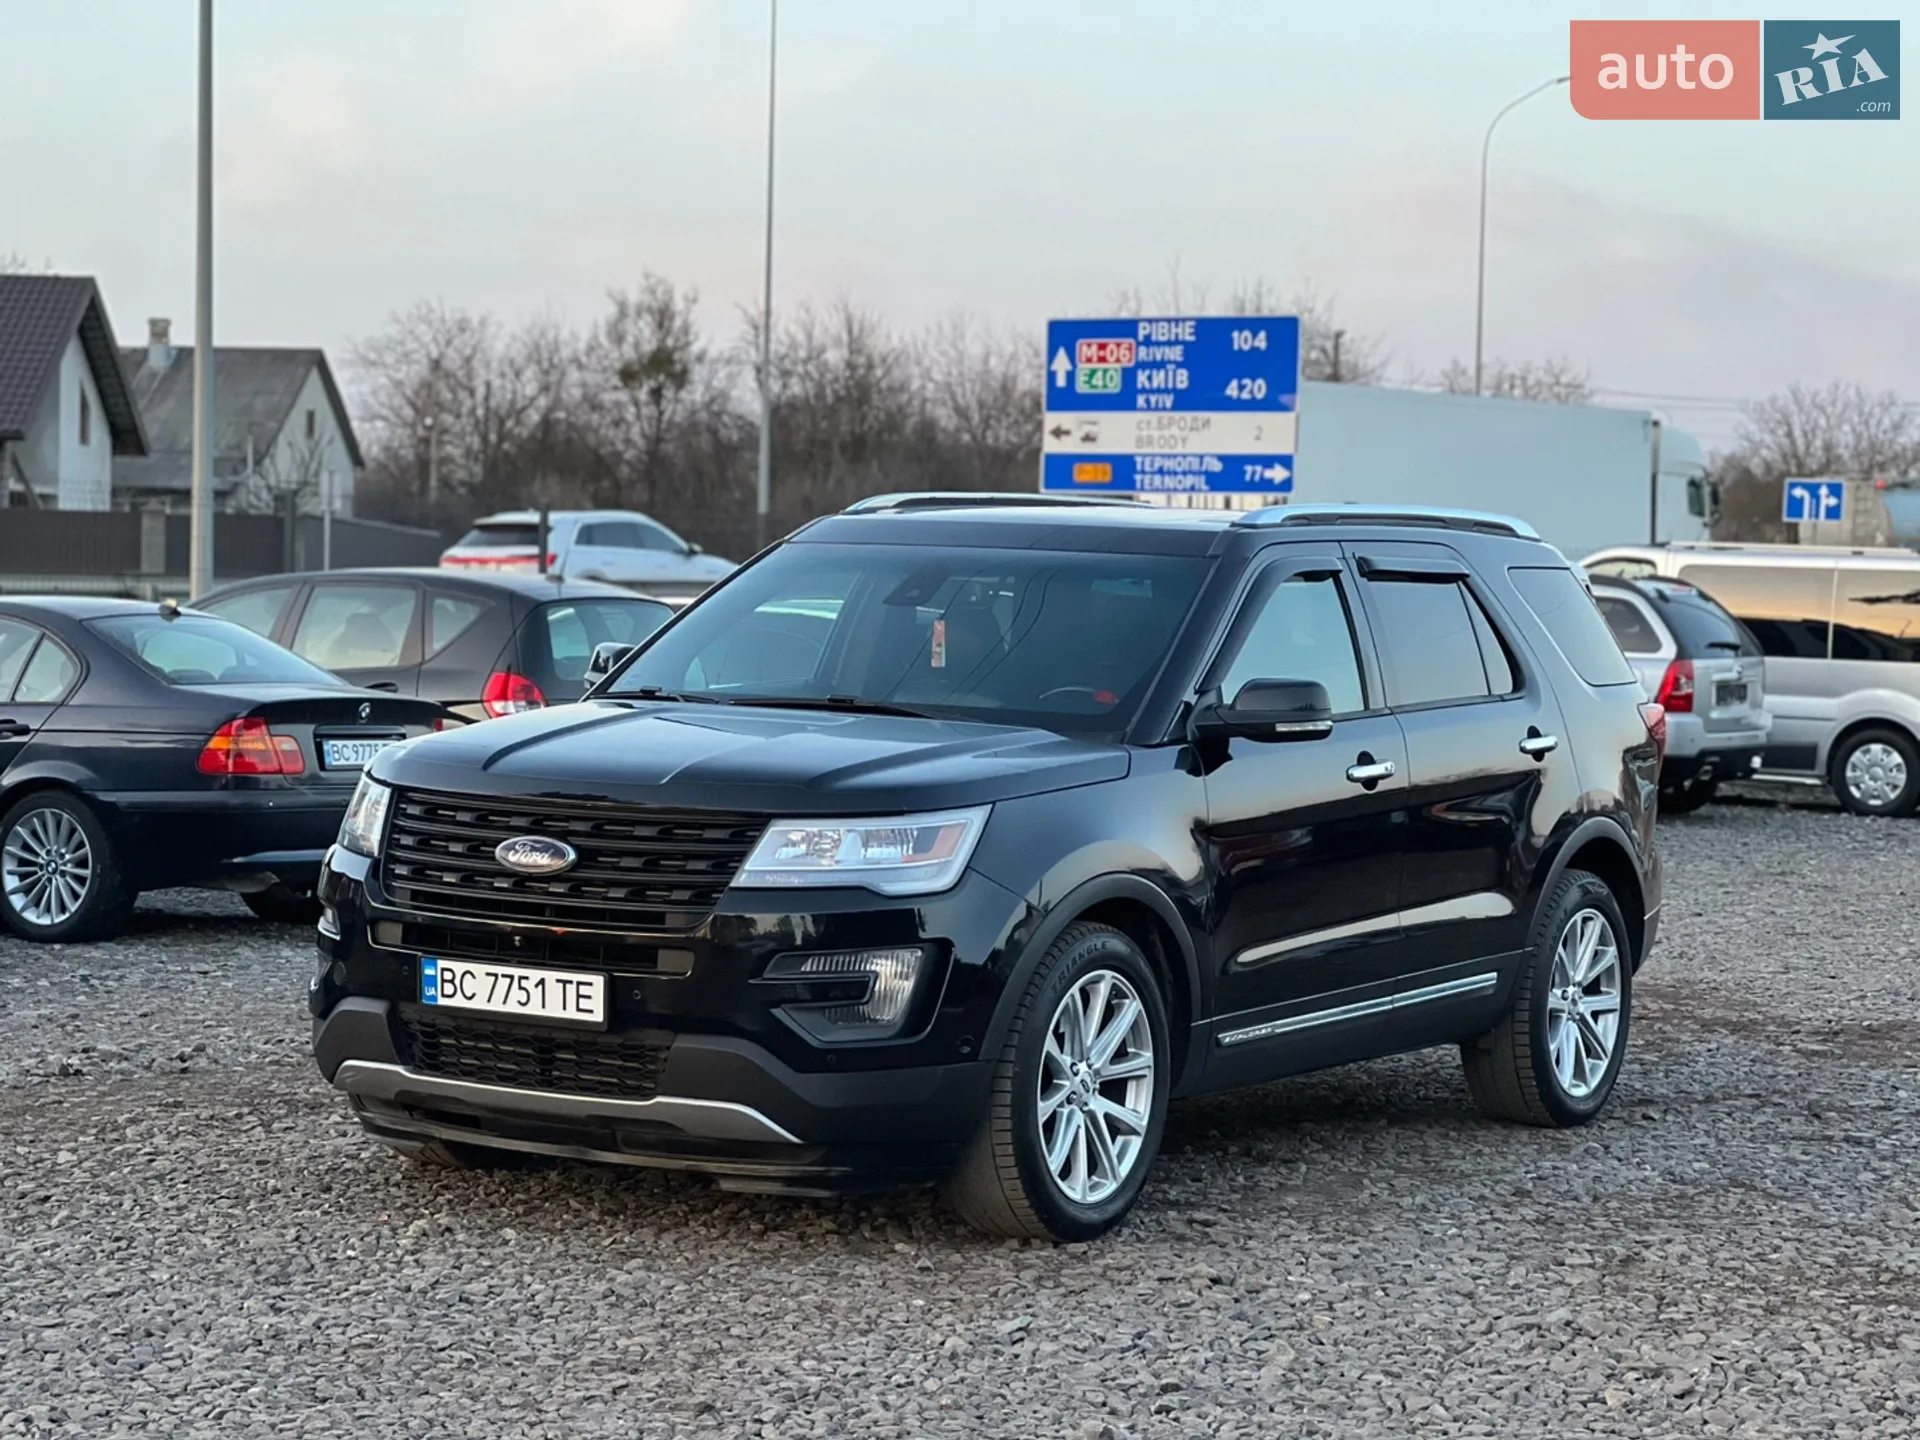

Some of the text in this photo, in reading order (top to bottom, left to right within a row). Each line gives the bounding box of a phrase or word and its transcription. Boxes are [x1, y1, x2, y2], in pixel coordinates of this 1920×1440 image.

[1137, 321, 1196, 342] РІВНЕ
[1231, 330, 1268, 351] 104
[1137, 346, 1184, 362] RIVNE
[1078, 370, 1118, 389] E40
[1136, 364, 1189, 390] КИЇВ
[1225, 378, 1267, 399] 420
[1136, 394, 1174, 409] KYIV
[1135, 434, 1188, 449] BRODY
[1254, 426, 1263, 440] 2
[1133, 455, 1223, 472] ТЕРНОПІЛЬ
[1133, 473, 1210, 491] TERNOPIL
[1243, 465, 1263, 482] 77
[331, 744, 350, 761] BC
[508, 841, 554, 865] Ford
[1051, 941, 1108, 995] TRIANGLE
[440, 967, 594, 1014] BC 7751 TE
